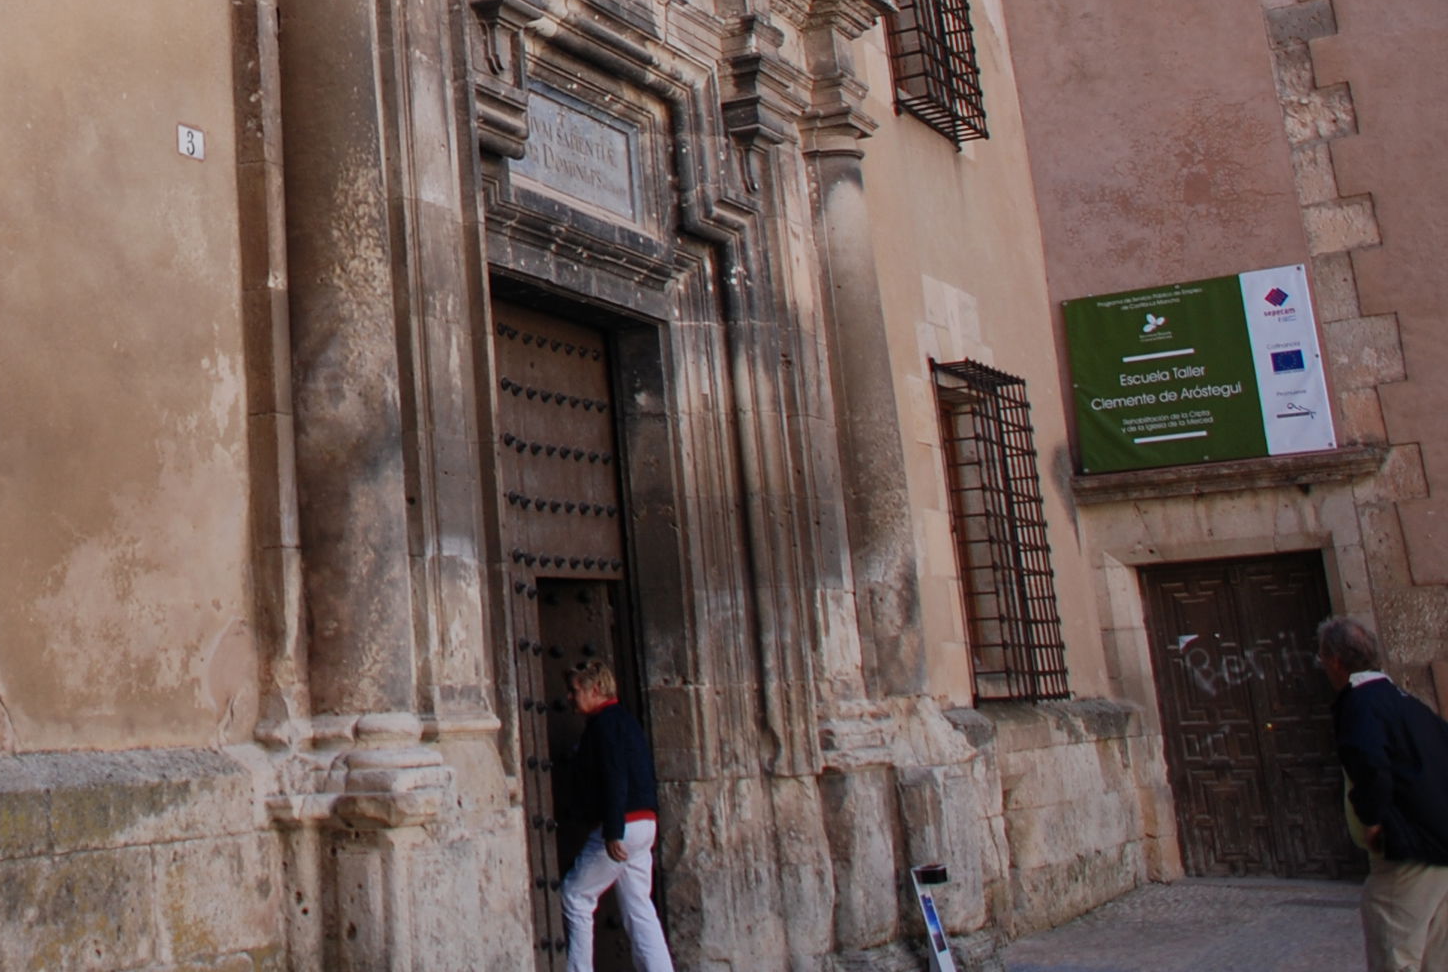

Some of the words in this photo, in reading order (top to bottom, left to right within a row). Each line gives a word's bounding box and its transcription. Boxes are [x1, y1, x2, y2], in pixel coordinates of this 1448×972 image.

[186, 130, 195, 156] 3
[1119, 370, 1170, 386] Escuela
[1172, 365, 1205, 379] Taller
[1090, 393, 1156, 411] Clemente
[1159, 390, 1177, 402] de
[1180, 381, 1242, 399] Aróstegui
